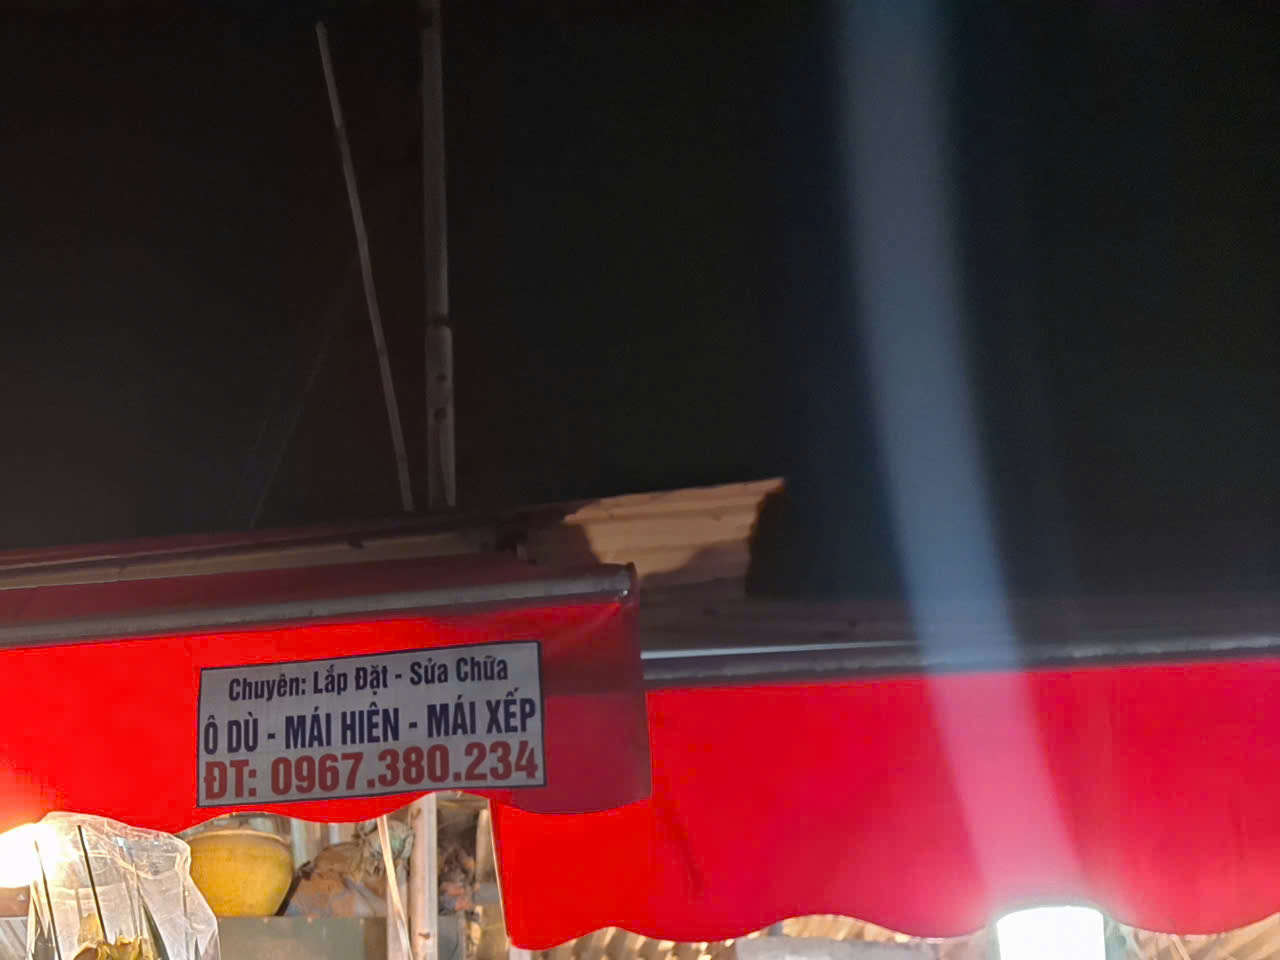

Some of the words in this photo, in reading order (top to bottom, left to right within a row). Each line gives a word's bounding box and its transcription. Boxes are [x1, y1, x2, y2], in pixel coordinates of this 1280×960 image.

[228, 676, 306, 702] Chuyên:
[313, 664, 348, 696] Lắp
[355, 665, 388, 696] Đặt
[410, 657, 448, 686] Sửa
[456, 655, 508, 682] Chữa
[204, 715, 218, 755] Ô
[227, 712, 258, 753] DÙ
[285, 706, 332, 750] MÁI
[341, 702, 400, 745] HIÊN
[427, 694, 476, 738] MÁI
[486, 687, 536, 734] XẾP
[204, 759, 257, 801] ĐT:
[271, 740, 538, 797] 0967.380.234
